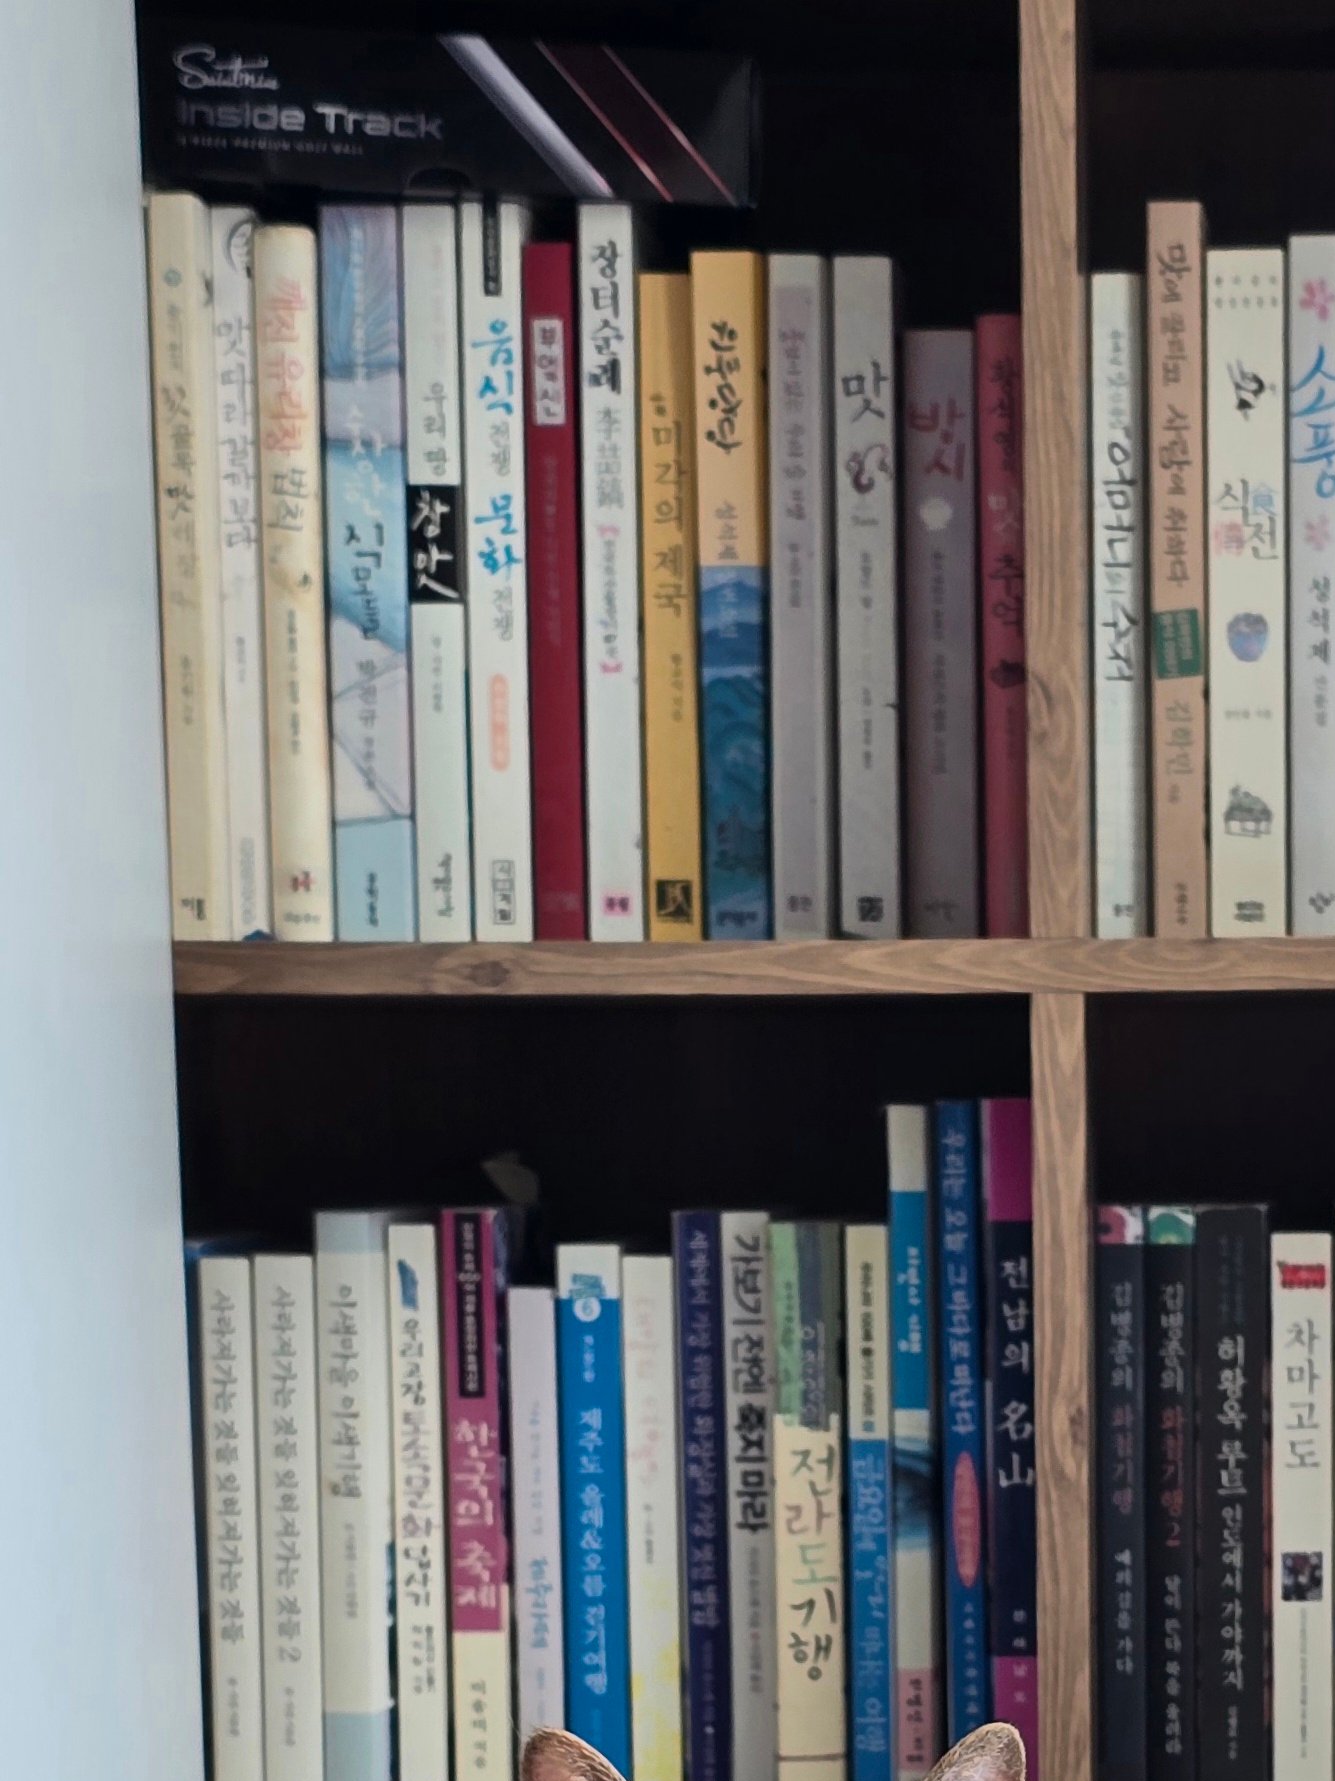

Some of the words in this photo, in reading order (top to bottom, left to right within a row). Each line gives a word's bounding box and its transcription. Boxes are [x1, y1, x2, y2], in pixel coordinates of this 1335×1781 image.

[176, 98, 306, 131] Inside
[312, 102, 446, 140] Track
[263, 352, 308, 455] 유리창
[268, 467, 308, 532] 법칙
[1102, 605, 1139, 682] 수저
[942, 1128, 966, 1200] 우리는
[730, 1234, 766, 1327] 가보기
[1000, 1256, 1031, 1374] 전남의
[210, 1284, 239, 1414] 사라져가는
[270, 1284, 299, 1410] 사라져가는
[328, 1283, 361, 1389] 이색마을
[732, 1334, 767, 1395] 전엔
[1110, 1281, 1134, 1391] 김병종의
[1159, 1281, 1185, 1395] 김병종의
[1217, 1333, 1247, 1430] 허황옥
[273, 1414, 299, 1462] 것들
[1284, 1316, 1323, 1470] 차마고도
[213, 1418, 240, 1465] 것들
[331, 1395, 363, 1500] 이색기행
[454, 1416, 500, 1528] 한국의
[577, 1407, 603, 1474] 제주도
[735, 1402, 773, 1534] 죽지마라
[998, 1398, 1034, 1489] 名山
[1216, 1438, 1248, 1496] 루트
[215, 1470, 244, 1593] 잊혀져가는
[274, 1467, 302, 1592] 잊혀져가는
[455, 1539, 500, 1610] 축제
[219, 1597, 245, 1646] 것들
[277, 1595, 303, 1641] 것들
[278, 1645, 303, 1664] 2
[1220, 1597, 1246, 1693] 가야까지
